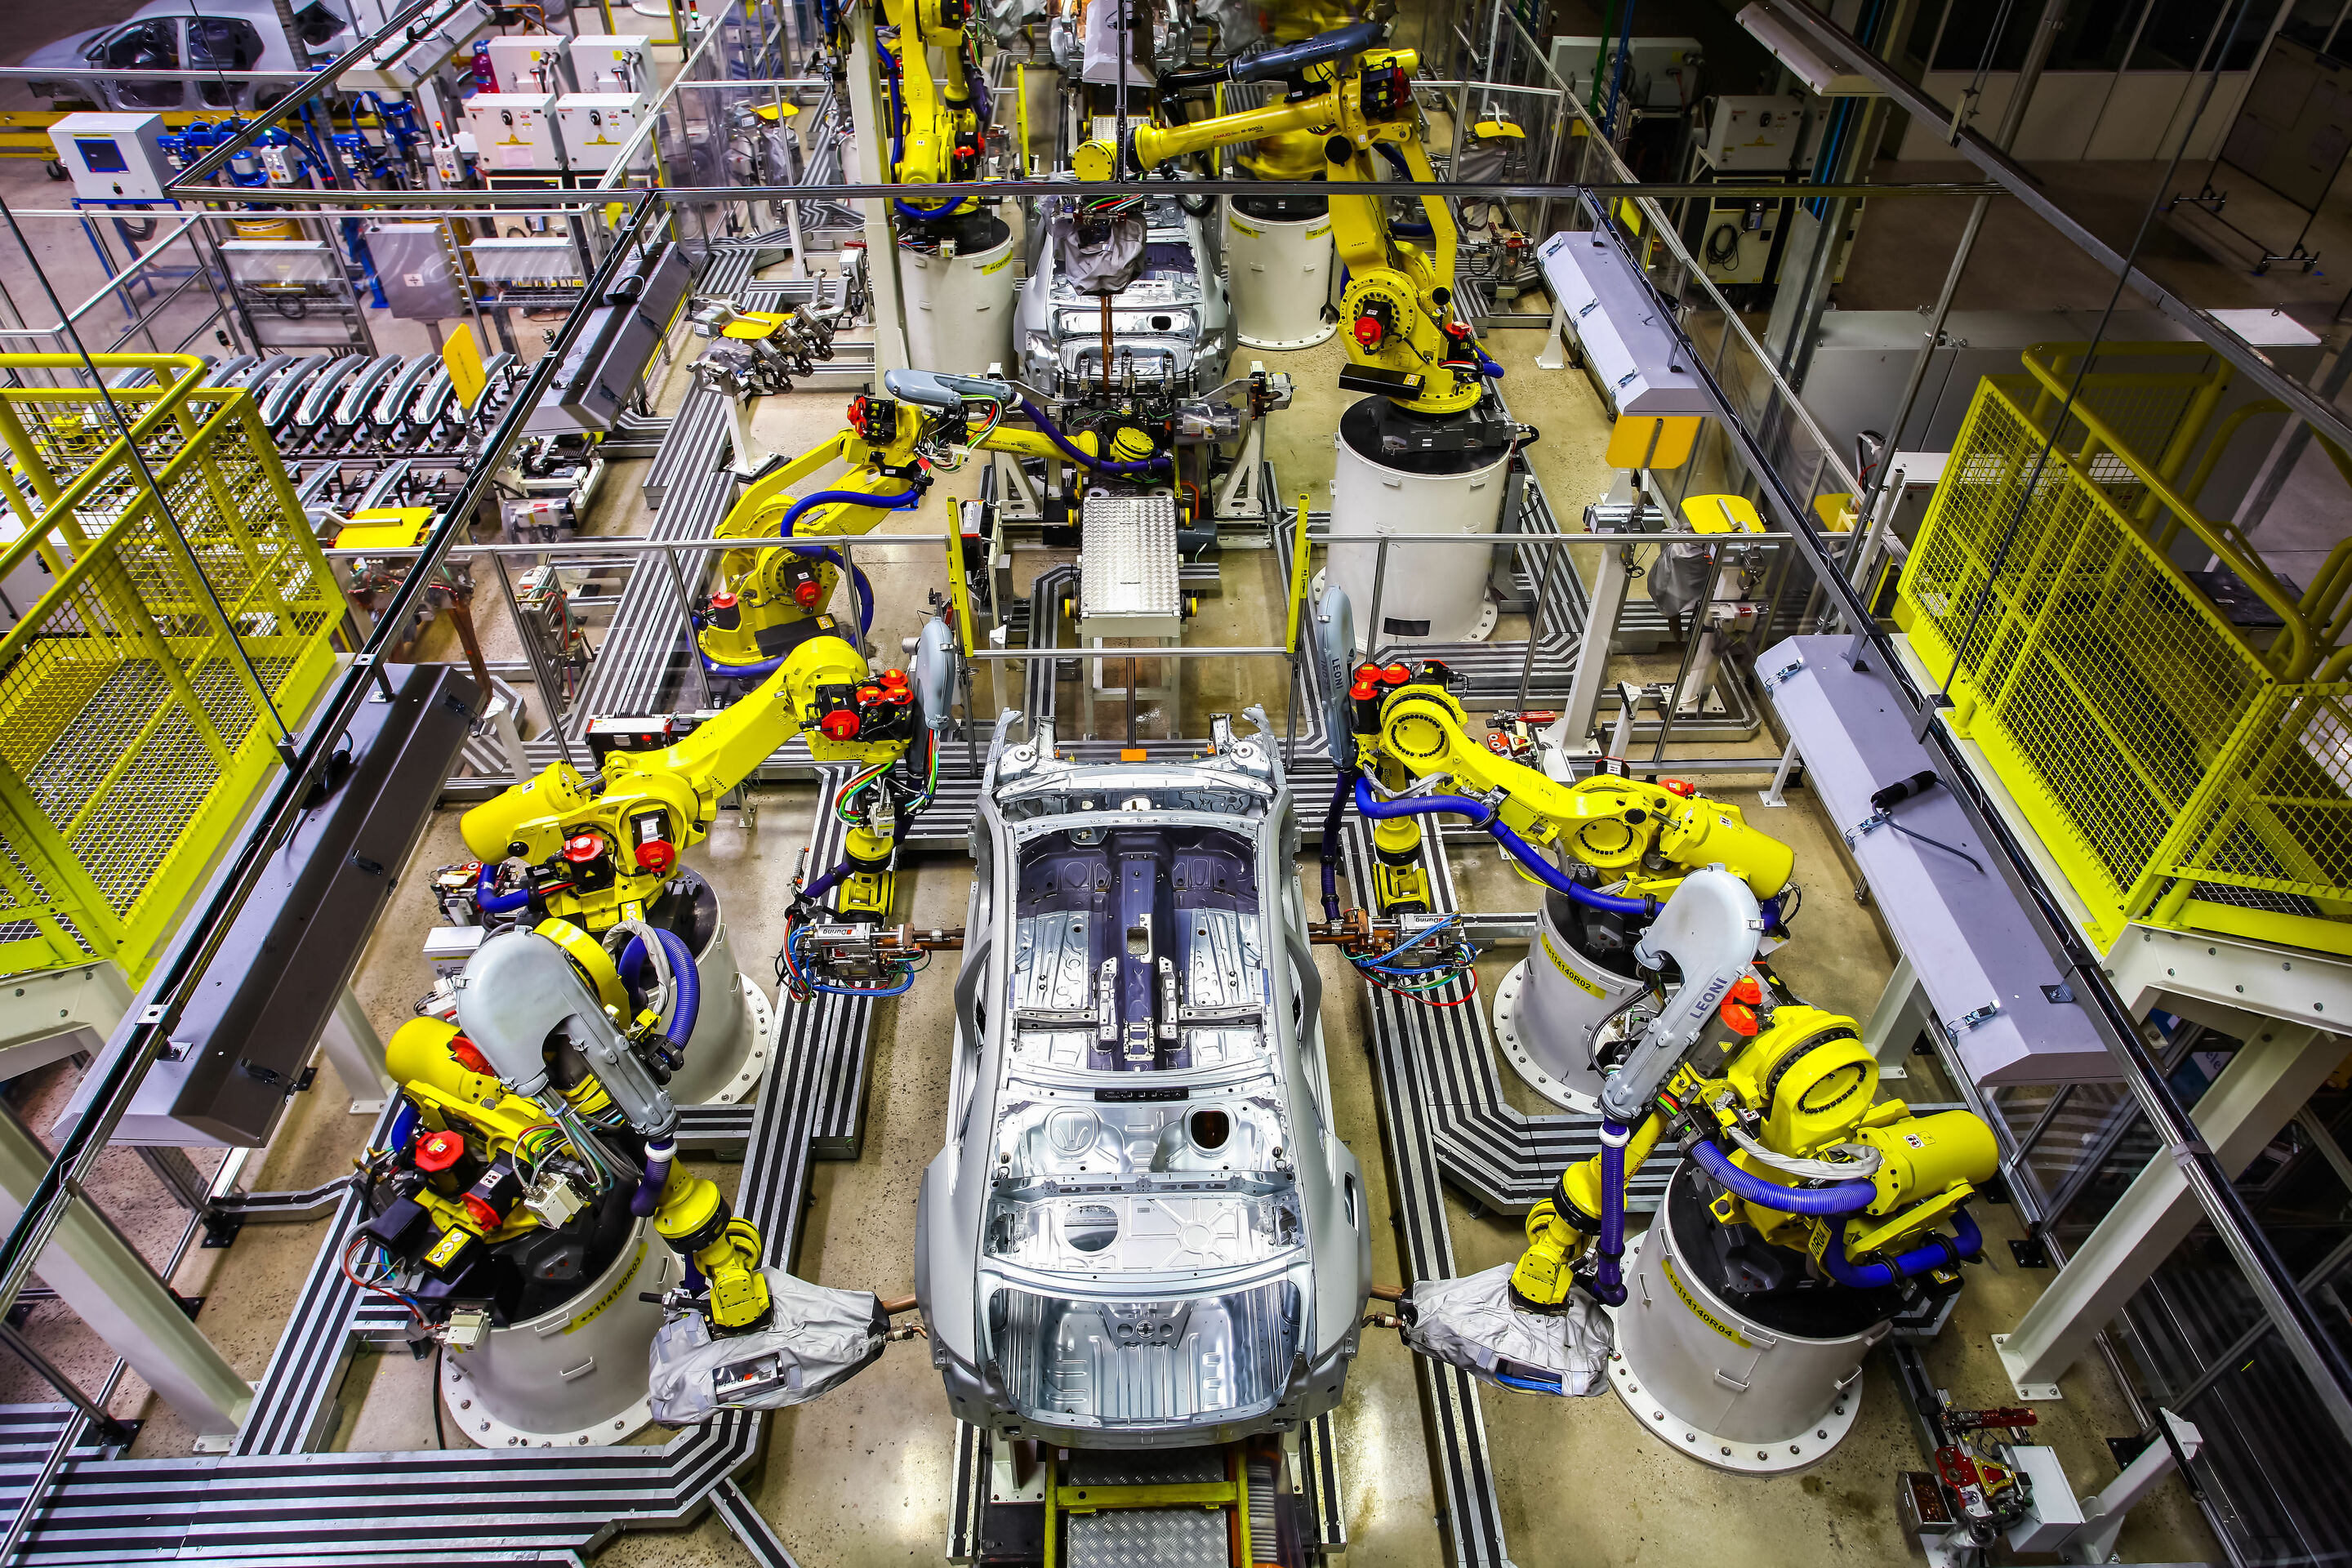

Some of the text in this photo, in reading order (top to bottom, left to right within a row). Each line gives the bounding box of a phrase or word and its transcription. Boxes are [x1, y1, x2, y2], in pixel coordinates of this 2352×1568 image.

[1332, 658, 1343, 689] LEONI
[1545, 944, 1592, 991] ++114140R02
[1689, 977, 1728, 1019] LEONI
[581, 1256, 641, 1322] ++114140R03
[1670, 1273, 1732, 1337] ++114140R04
